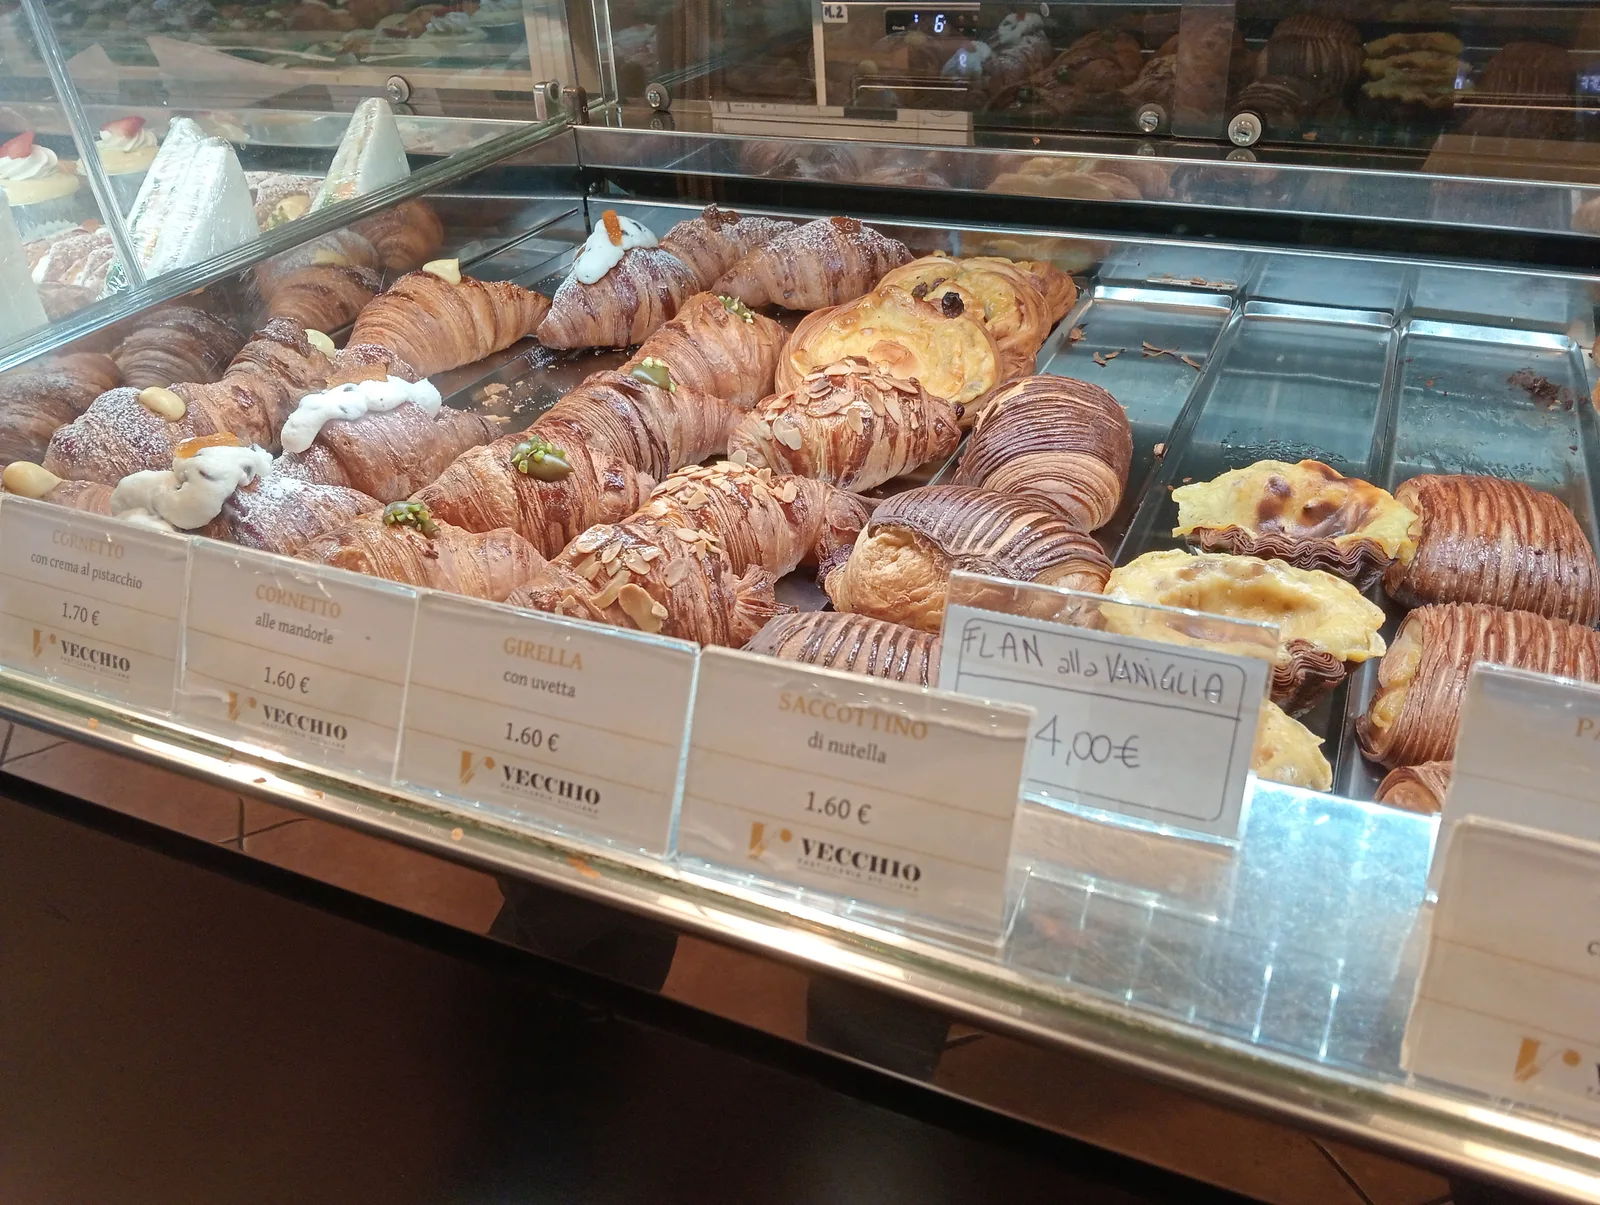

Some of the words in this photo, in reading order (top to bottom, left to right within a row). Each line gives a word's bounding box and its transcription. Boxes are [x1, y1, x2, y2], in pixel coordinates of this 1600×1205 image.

[52, 529, 125, 560] CORNETTO
[31, 553, 48, 566] con
[49, 557, 79, 574] crema
[80, 562, 90, 577] al
[92, 567, 143, 590] pistacchio
[62, 602, 88, 623] 1.70
[91, 610, 100, 627] €
[255, 583, 342, 620] CORNETTO
[255, 612, 276, 630] alle
[278, 620, 334, 645] mandorle
[60, 639, 131, 672] VECCHIO
[503, 636, 584, 671] GIRELLA
[962, 626, 1044, 668] FLAN
[1057, 648, 1099, 677] alla
[264, 666, 296, 690] 1.60
[299, 676, 311, 694] €
[503, 669, 528, 687] con
[532, 676, 576, 699] uvetta
[262, 703, 348, 741] VECCHIO
[777, 692, 930, 742] SACCOTTINO
[504, 722, 543, 748] 1.60
[547, 733, 560, 753] €
[807, 731, 824, 751] di
[828, 740, 888, 765] nutella
[503, 764, 602, 806] VECCHIO
[803, 790, 852, 820] 1.60
[857, 803, 873, 826] €
[801, 837, 922, 882] VECCHIO
